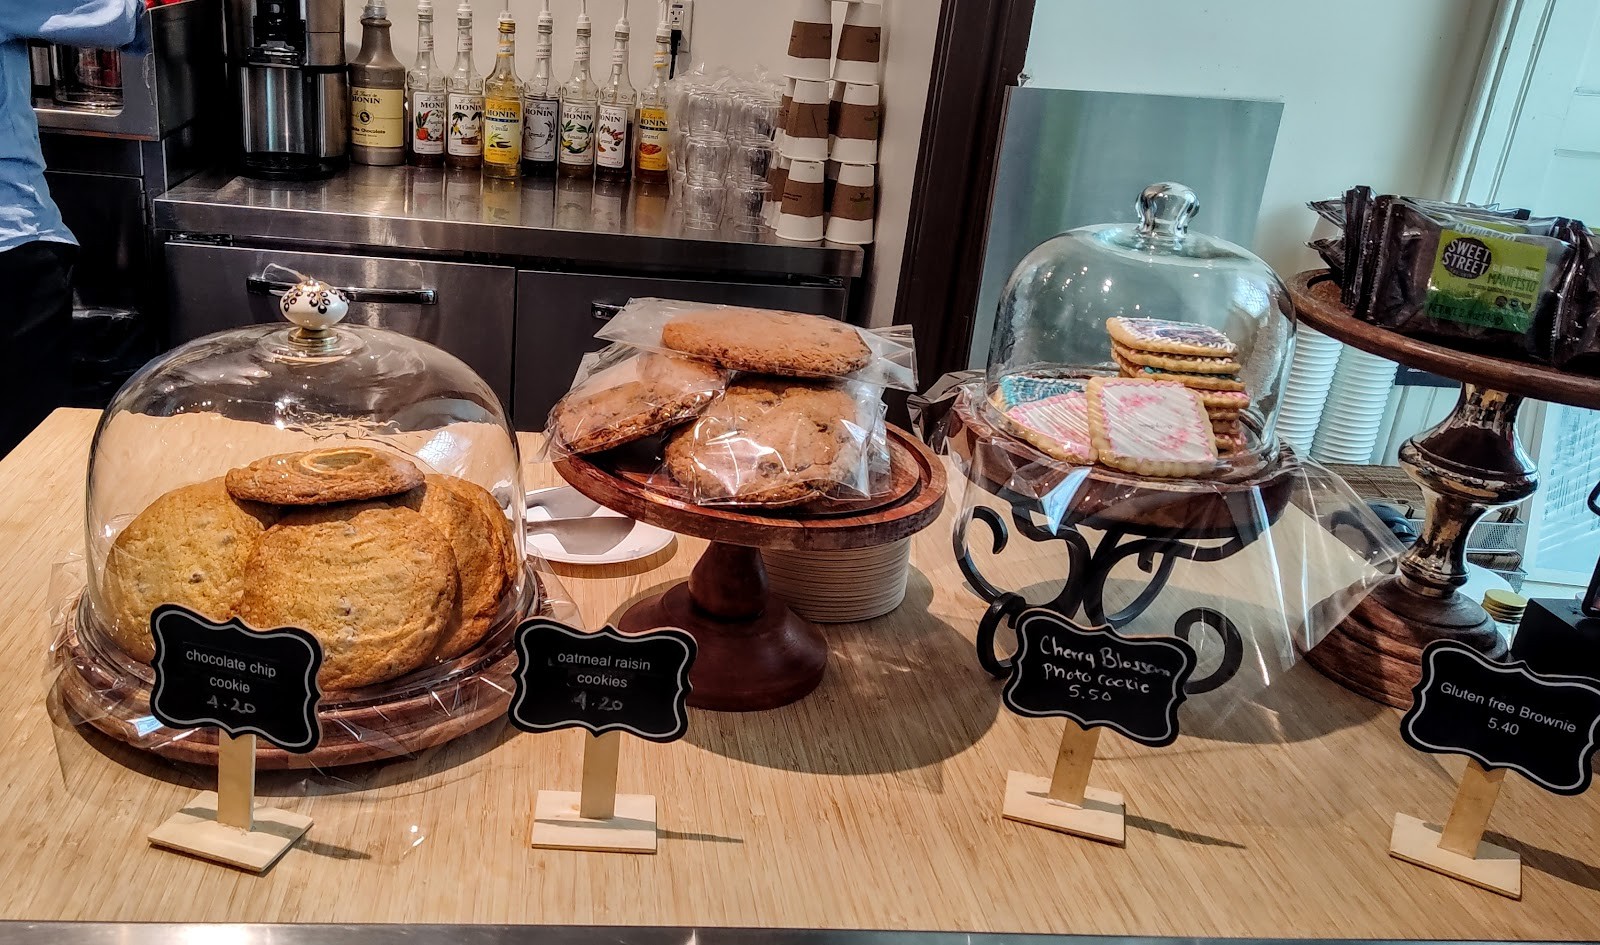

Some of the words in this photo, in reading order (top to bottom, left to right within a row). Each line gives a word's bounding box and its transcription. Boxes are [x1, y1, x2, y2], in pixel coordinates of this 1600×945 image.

[487, 109, 516, 118] MONIN
[563, 112, 592, 121] MONIN
[600, 114, 620, 123] ONIN
[1448, 239, 1491, 263] SWEET
[1442, 252, 1488, 276] STREET
[1487, 273, 1539, 292] MANIFESTO
[558, 652, 612, 667] oatmeal
[615, 656, 651, 671] raisin
[1040, 635, 1095, 669] Cherry
[186, 649, 246, 671] chocolate
[250, 662, 276, 678] chip
[210, 676, 250, 694] cookie
[577, 673, 628, 688] cookies
[1069, 684, 1112, 701] 5.50
[206, 694, 256, 714] 4.20
[1440, 682, 1485, 705] Gluten
[1488, 696, 1515, 715] free
[1519, 706, 1577, 733] Brownie
[1487, 717, 1520, 736] 5.40
